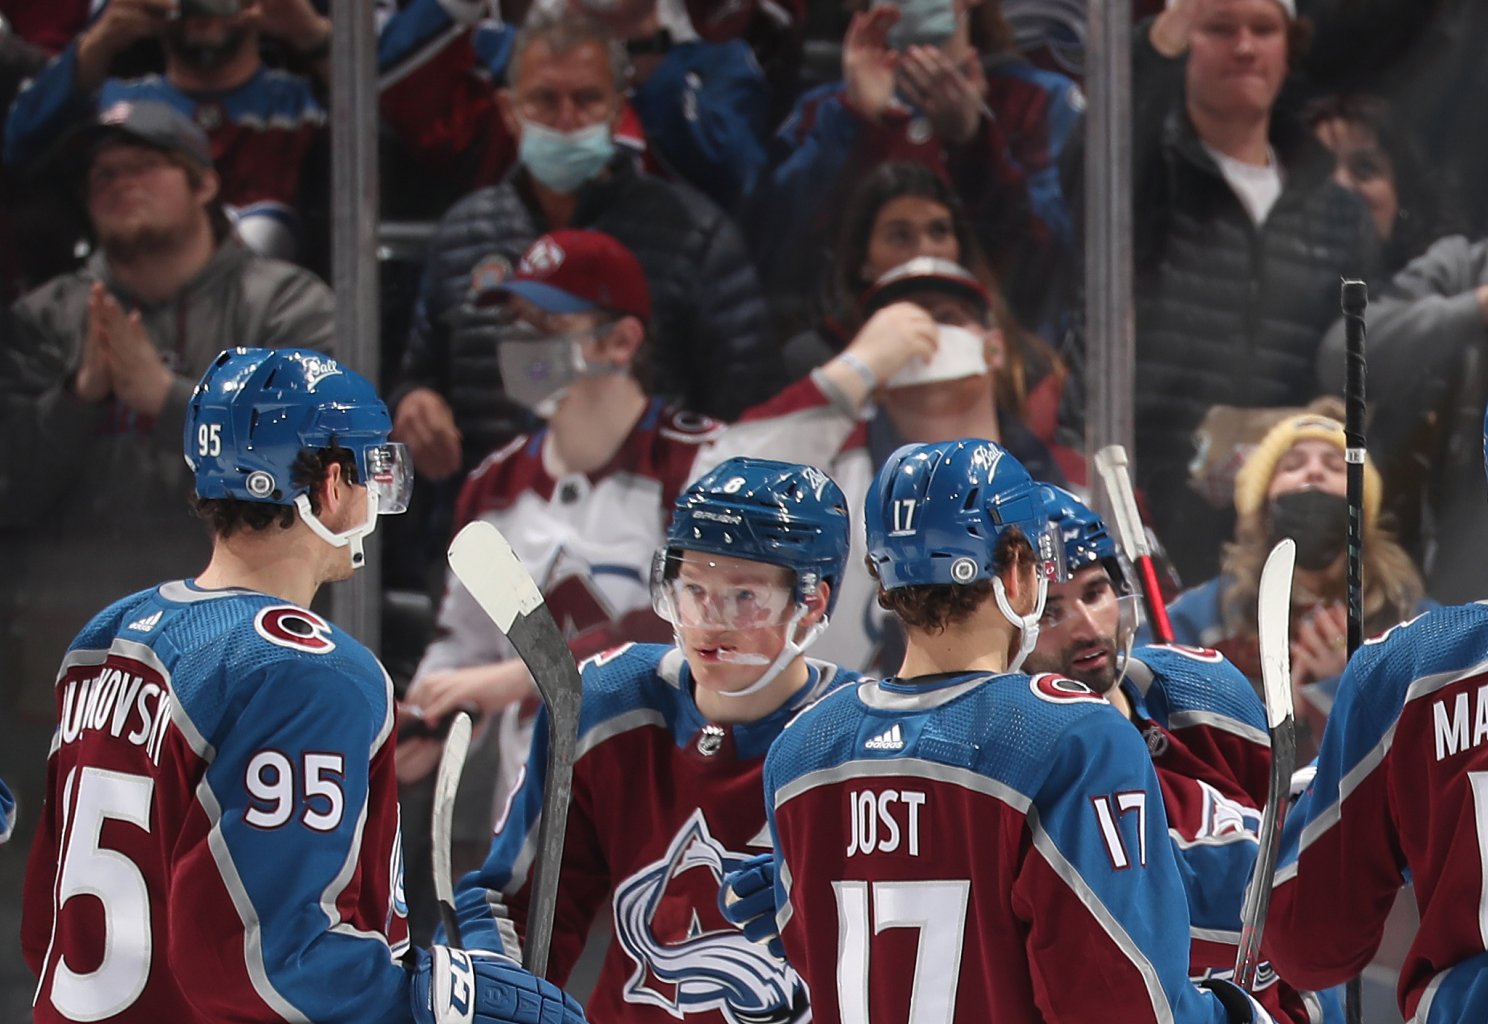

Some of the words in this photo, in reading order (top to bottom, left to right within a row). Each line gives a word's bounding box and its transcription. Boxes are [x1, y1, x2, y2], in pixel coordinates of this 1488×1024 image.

[198, 424, 221, 457] 95
[894, 500, 917, 531] 17
[244, 749, 347, 833] 95
[846, 788, 926, 858] JOST
[1090, 789, 1147, 871] 17
